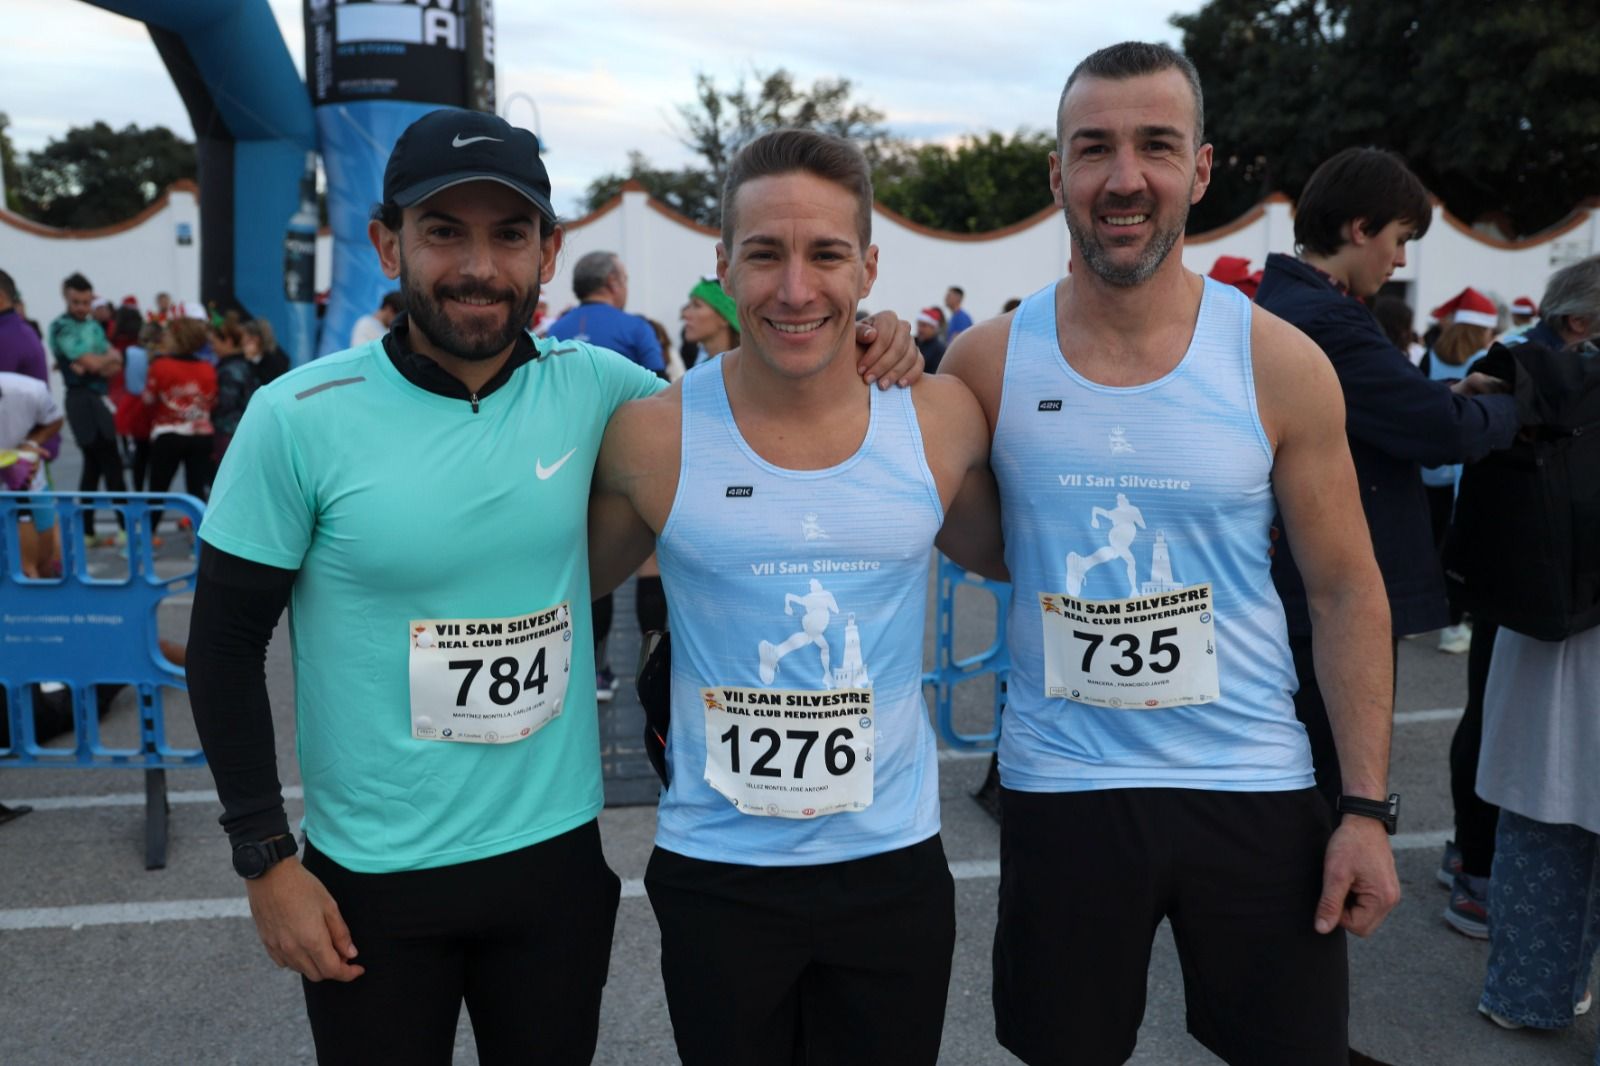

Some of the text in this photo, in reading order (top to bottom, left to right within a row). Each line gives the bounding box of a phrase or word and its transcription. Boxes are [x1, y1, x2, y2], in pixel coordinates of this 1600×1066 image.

[1058, 474, 1191, 490] VII San Silvestre
[751, 559, 880, 576] VII San Silvestre
[1061, 587, 1209, 614] VII SAN SILVESTRE
[1064, 611, 1090, 624] REAL
[1092, 617, 1121, 625] CLUB
[436, 624, 460, 636] VII
[466, 623, 503, 635] SAN
[438, 640, 469, 649] REAL
[472, 639, 502, 648] CLUB
[1073, 627, 1181, 677] 735
[448, 646, 549, 707] 784
[723, 691, 870, 706] VII SAN SILVESTRE
[726, 706, 751, 716] REAL
[753, 709, 781, 718] CLUB
[721, 724, 856, 779] 1276
